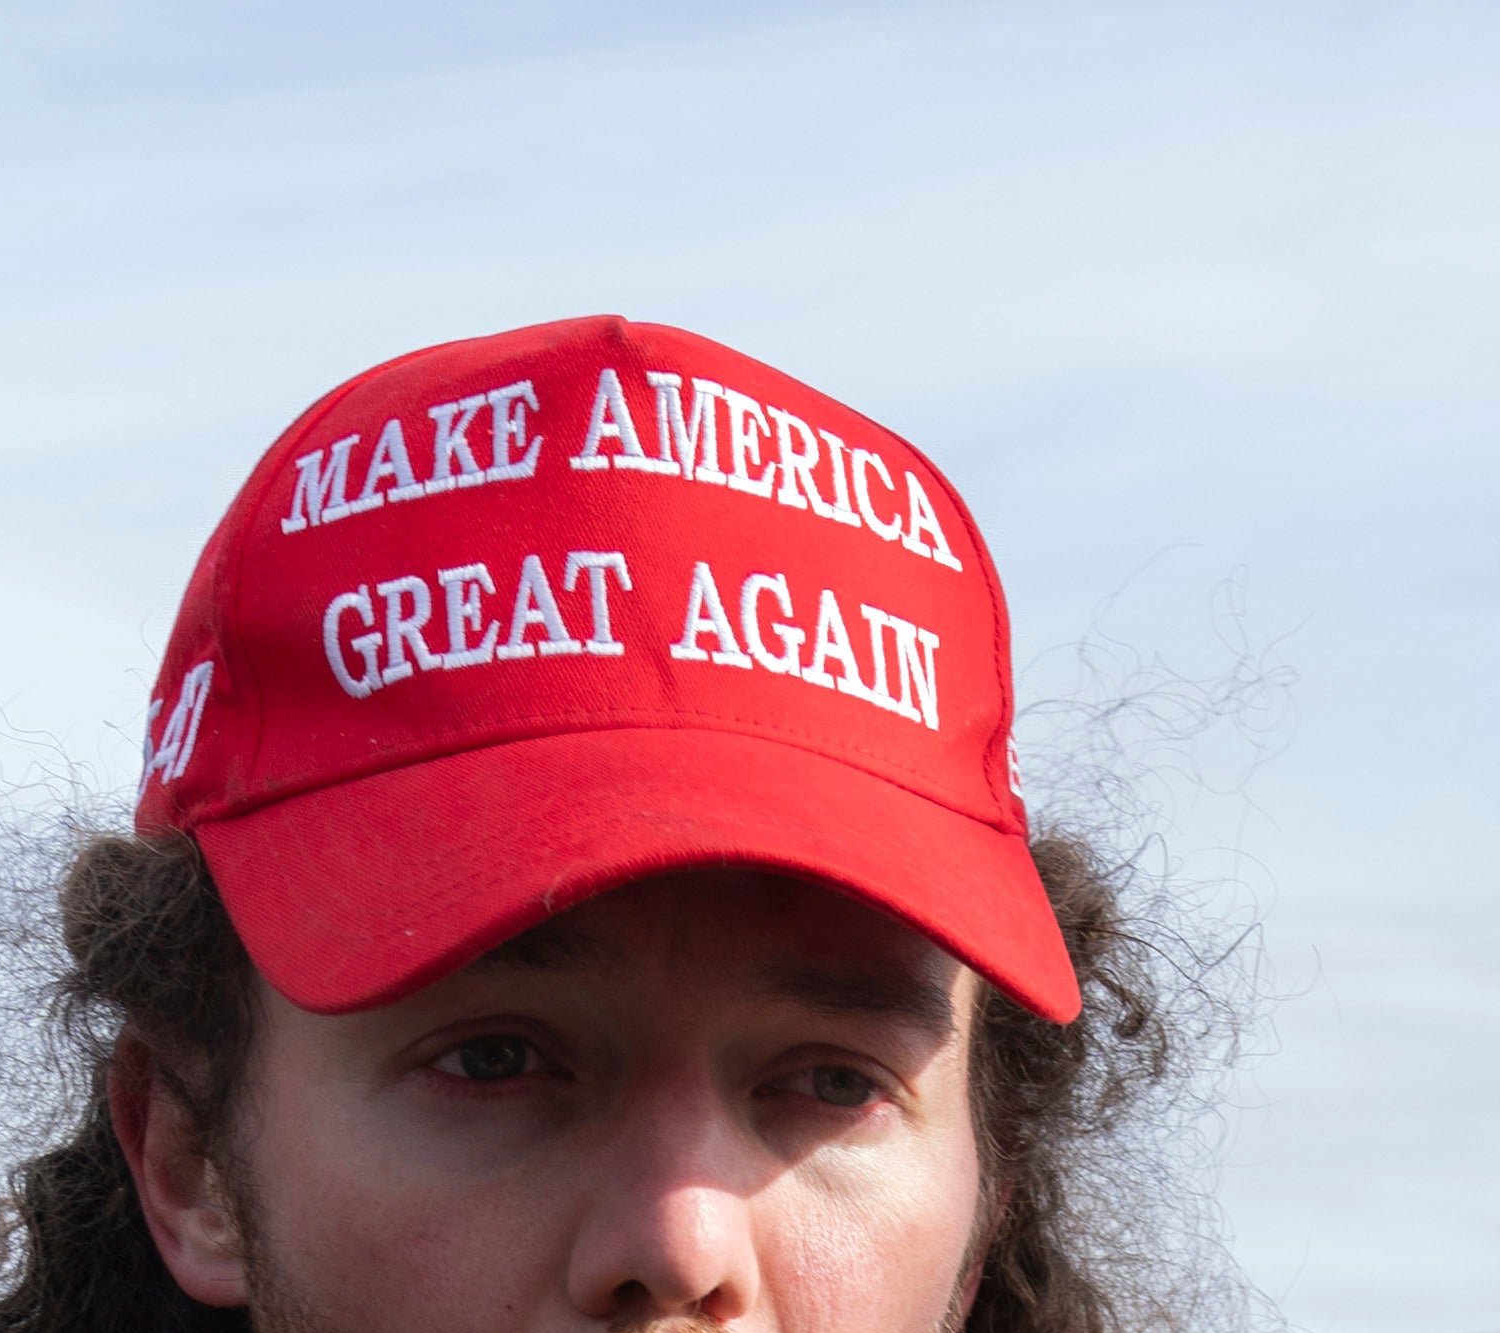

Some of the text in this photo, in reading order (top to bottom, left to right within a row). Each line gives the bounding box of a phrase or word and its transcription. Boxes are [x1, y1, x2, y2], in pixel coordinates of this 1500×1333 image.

[280, 368, 964, 573] MAKE AMERICA
[322, 550, 941, 733] GREAT AGAIN
